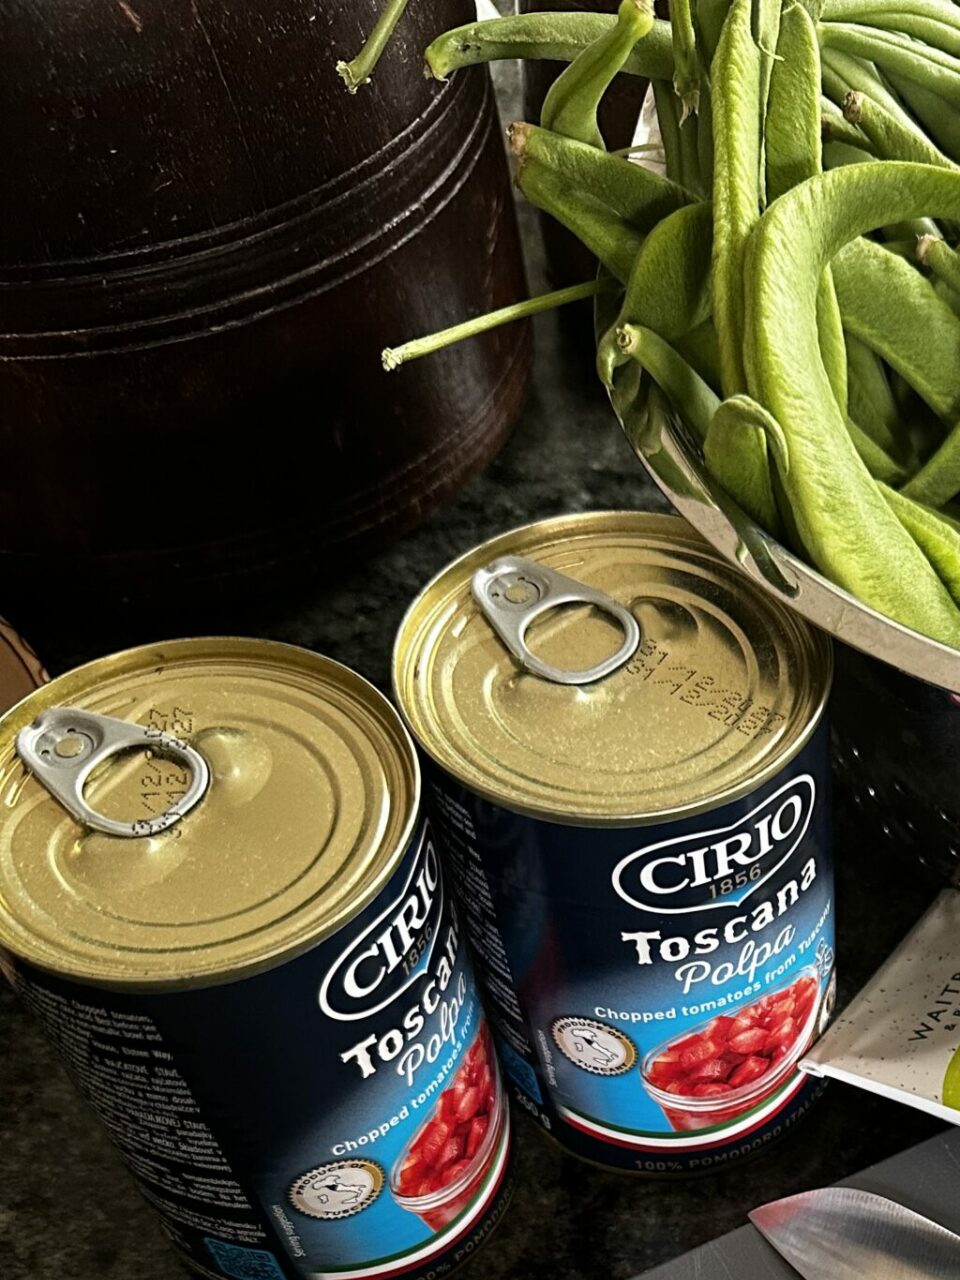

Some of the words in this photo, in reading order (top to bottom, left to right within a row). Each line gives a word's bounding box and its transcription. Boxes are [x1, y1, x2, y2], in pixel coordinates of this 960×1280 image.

[640, 795, 802, 894] CIRIO
[621, 858, 817, 965] Toscana
[708, 863, 762, 899] 1856
[344, 840, 438, 998] CIRIO
[402, 923, 434, 976] 1856
[594, 1006, 676, 1023] Chopped
[682, 982, 761, 1017] tomatoes
[765, 954, 796, 985] from
[798, 899, 831, 955] Tuscany
[675, 924, 796, 994] Polpa
[397, 972, 467, 1086] Polpa
[944, 1022, 956, 1032] &
[332, 1108, 410, 1156] Chopped
[411, 1040, 463, 1109] tomatoes
[296, 1164, 347, 1196] PRODUCE
[350, 1163, 367, 1171] OF
[635, 1160, 683, 1171] 100%
[689, 1126, 782, 1169] POMODORO
[324, 1189, 377, 1216] TUSCANY
